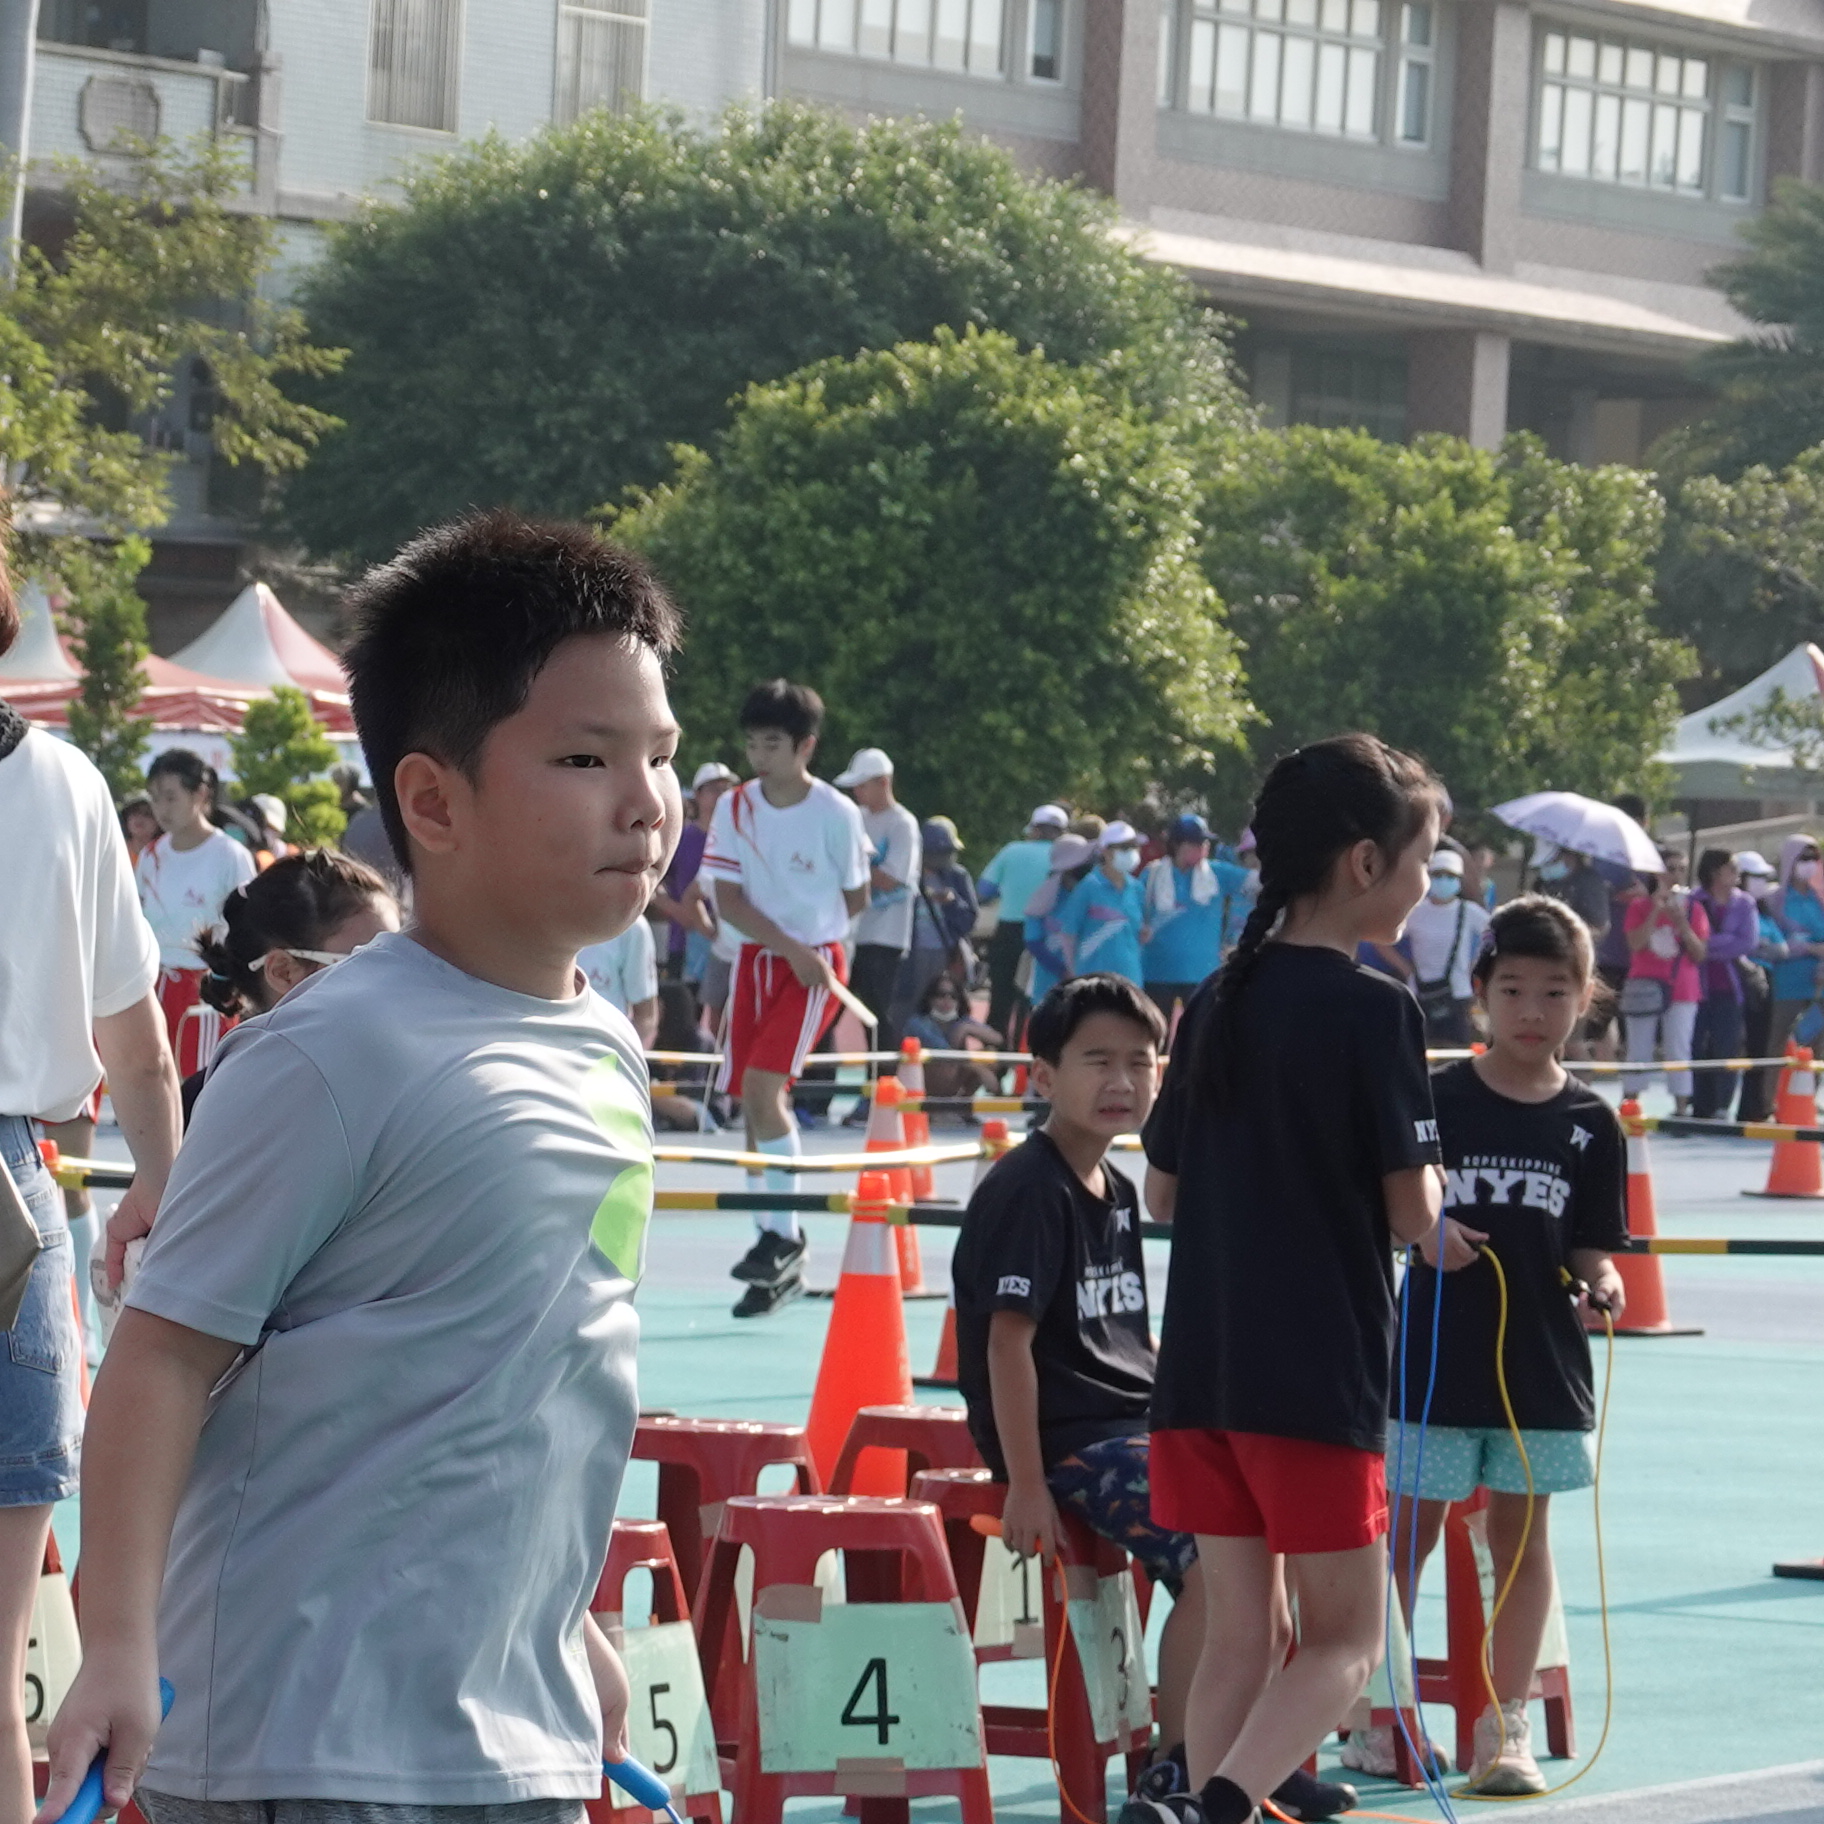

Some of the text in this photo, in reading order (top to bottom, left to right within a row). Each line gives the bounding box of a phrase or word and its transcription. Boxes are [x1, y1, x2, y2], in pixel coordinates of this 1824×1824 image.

[1443, 1167, 1571, 1219] NYES
[840, 1657, 900, 1745] 4
[1111, 1626, 1129, 1711] 3
[649, 1682, 678, 1775] 5
